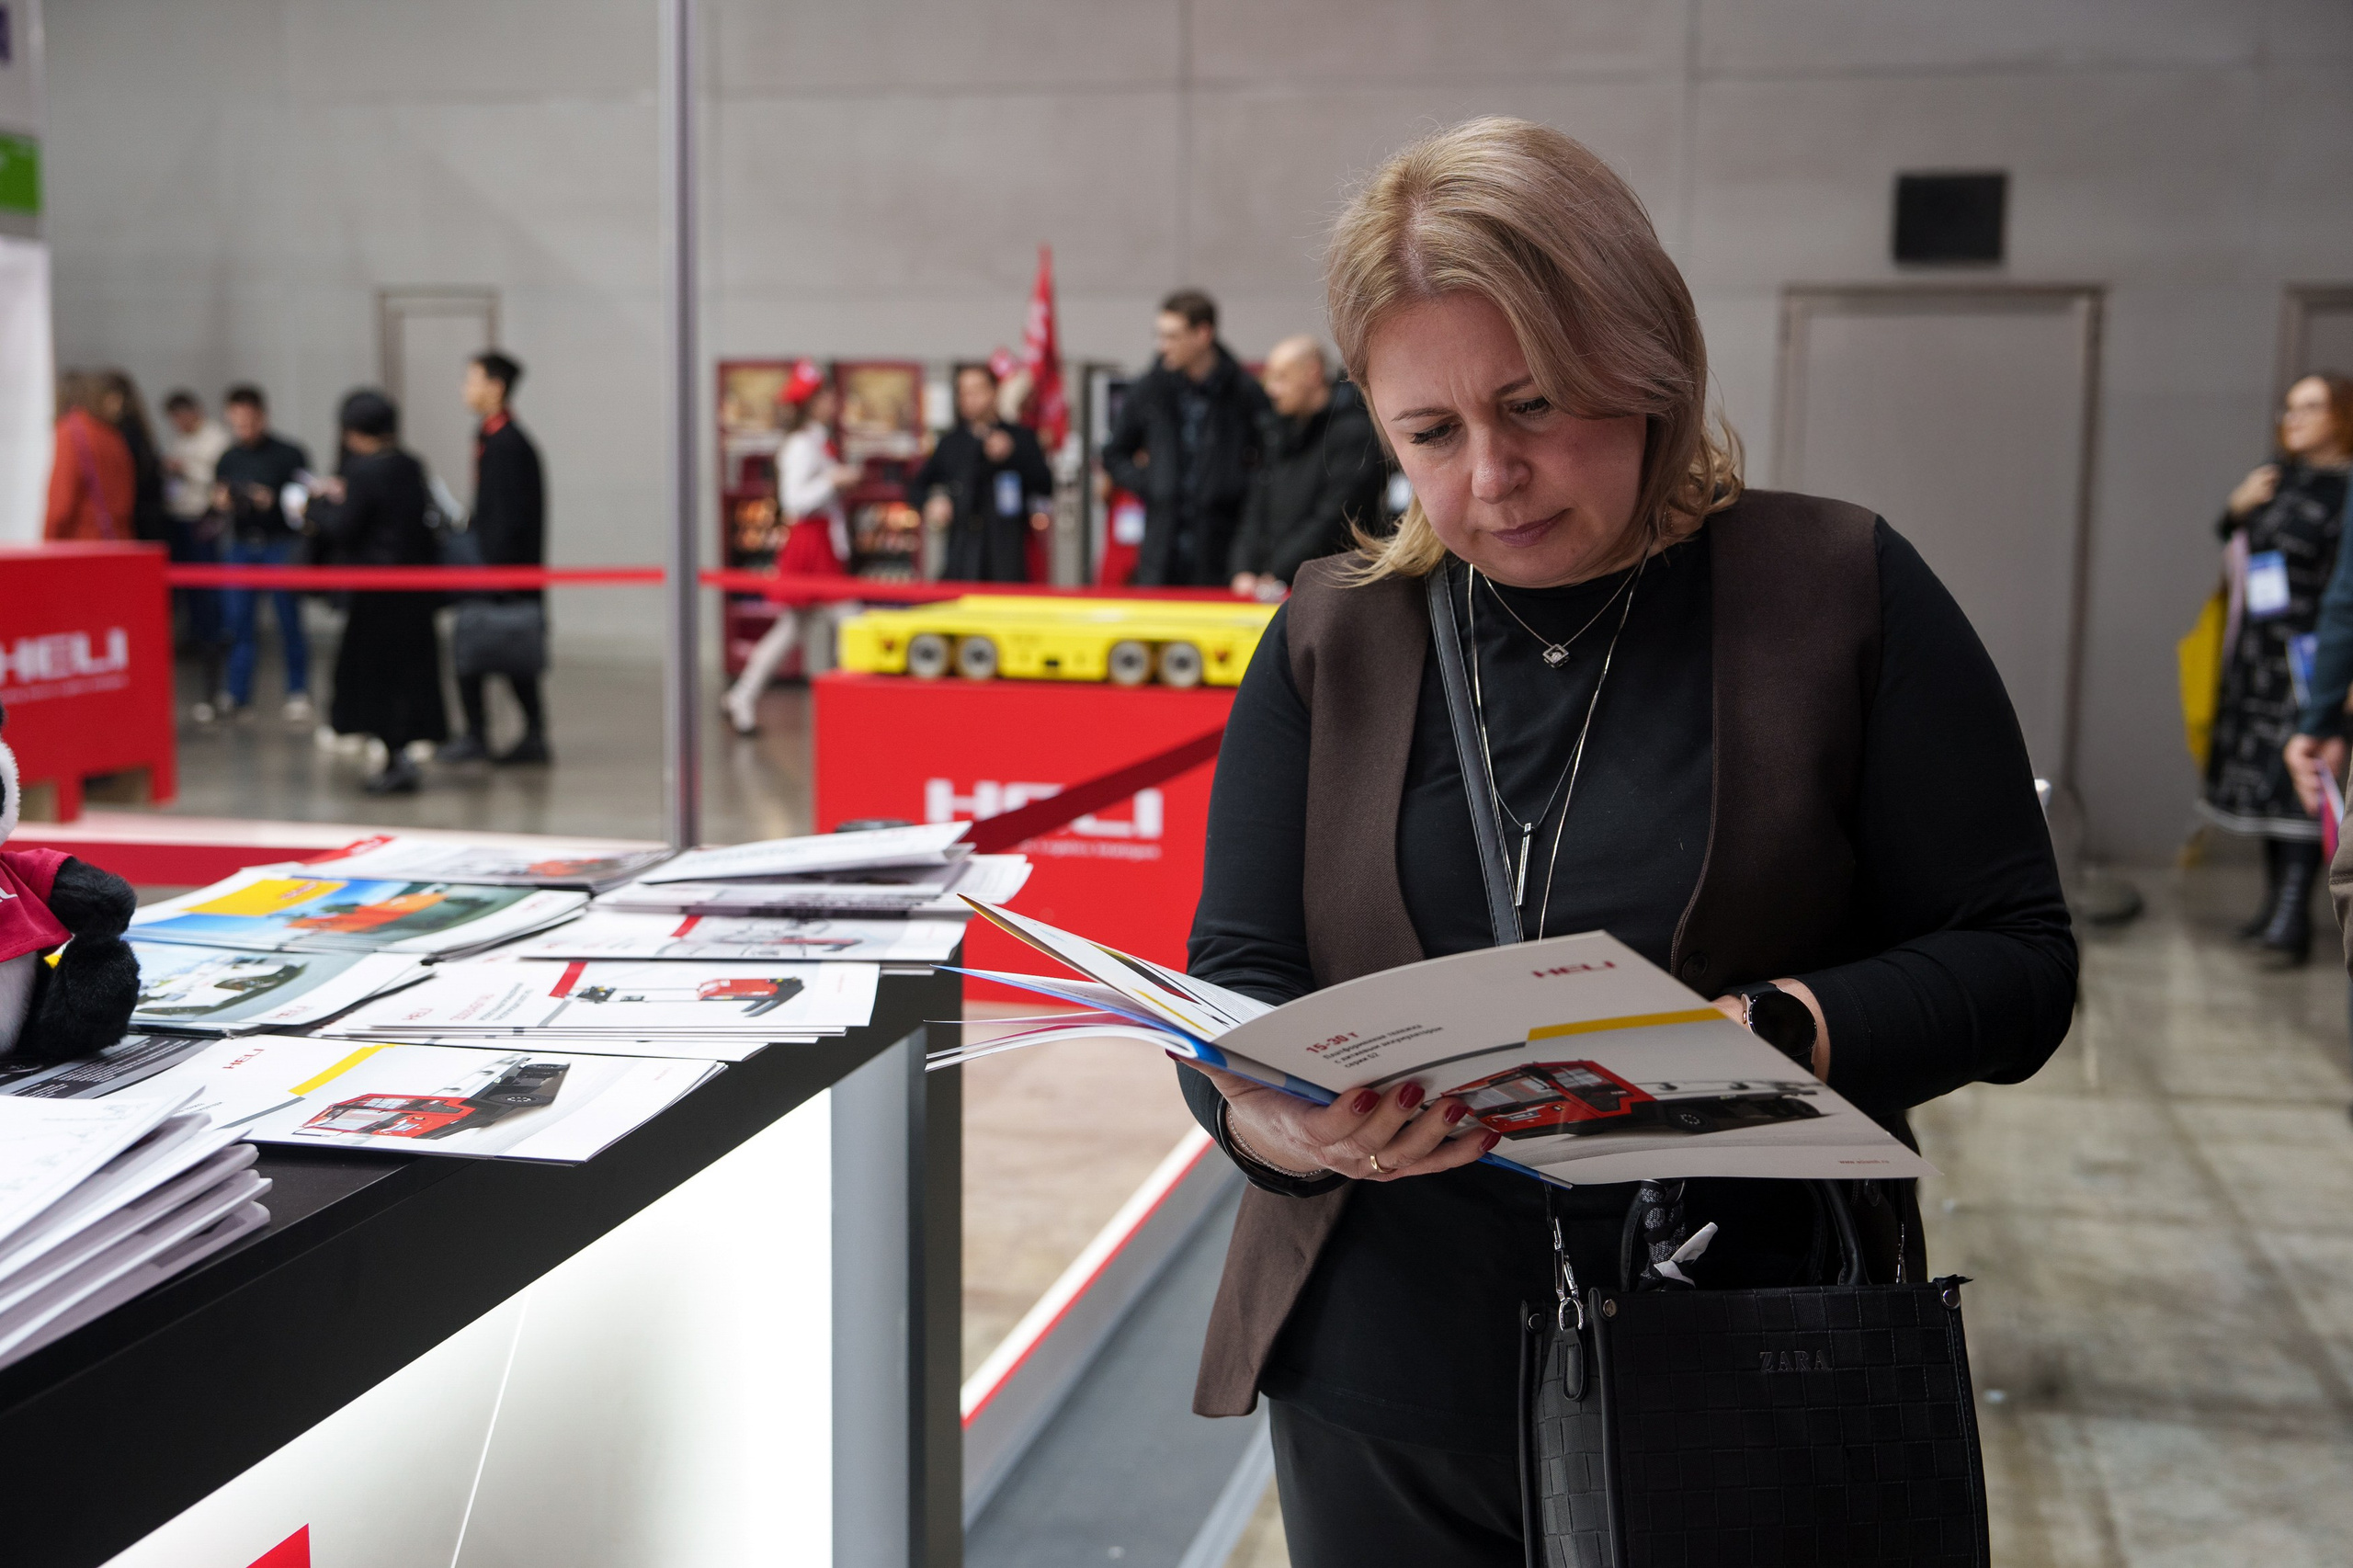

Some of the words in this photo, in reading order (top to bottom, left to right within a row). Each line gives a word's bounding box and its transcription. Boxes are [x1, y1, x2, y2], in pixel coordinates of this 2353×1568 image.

[1531, 960, 1617, 978] HELI
[1306, 1034, 1348, 1053] 15-30
[222, 1048, 266, 1069] HELI
[1758, 1349, 1834, 1372] ZARA
